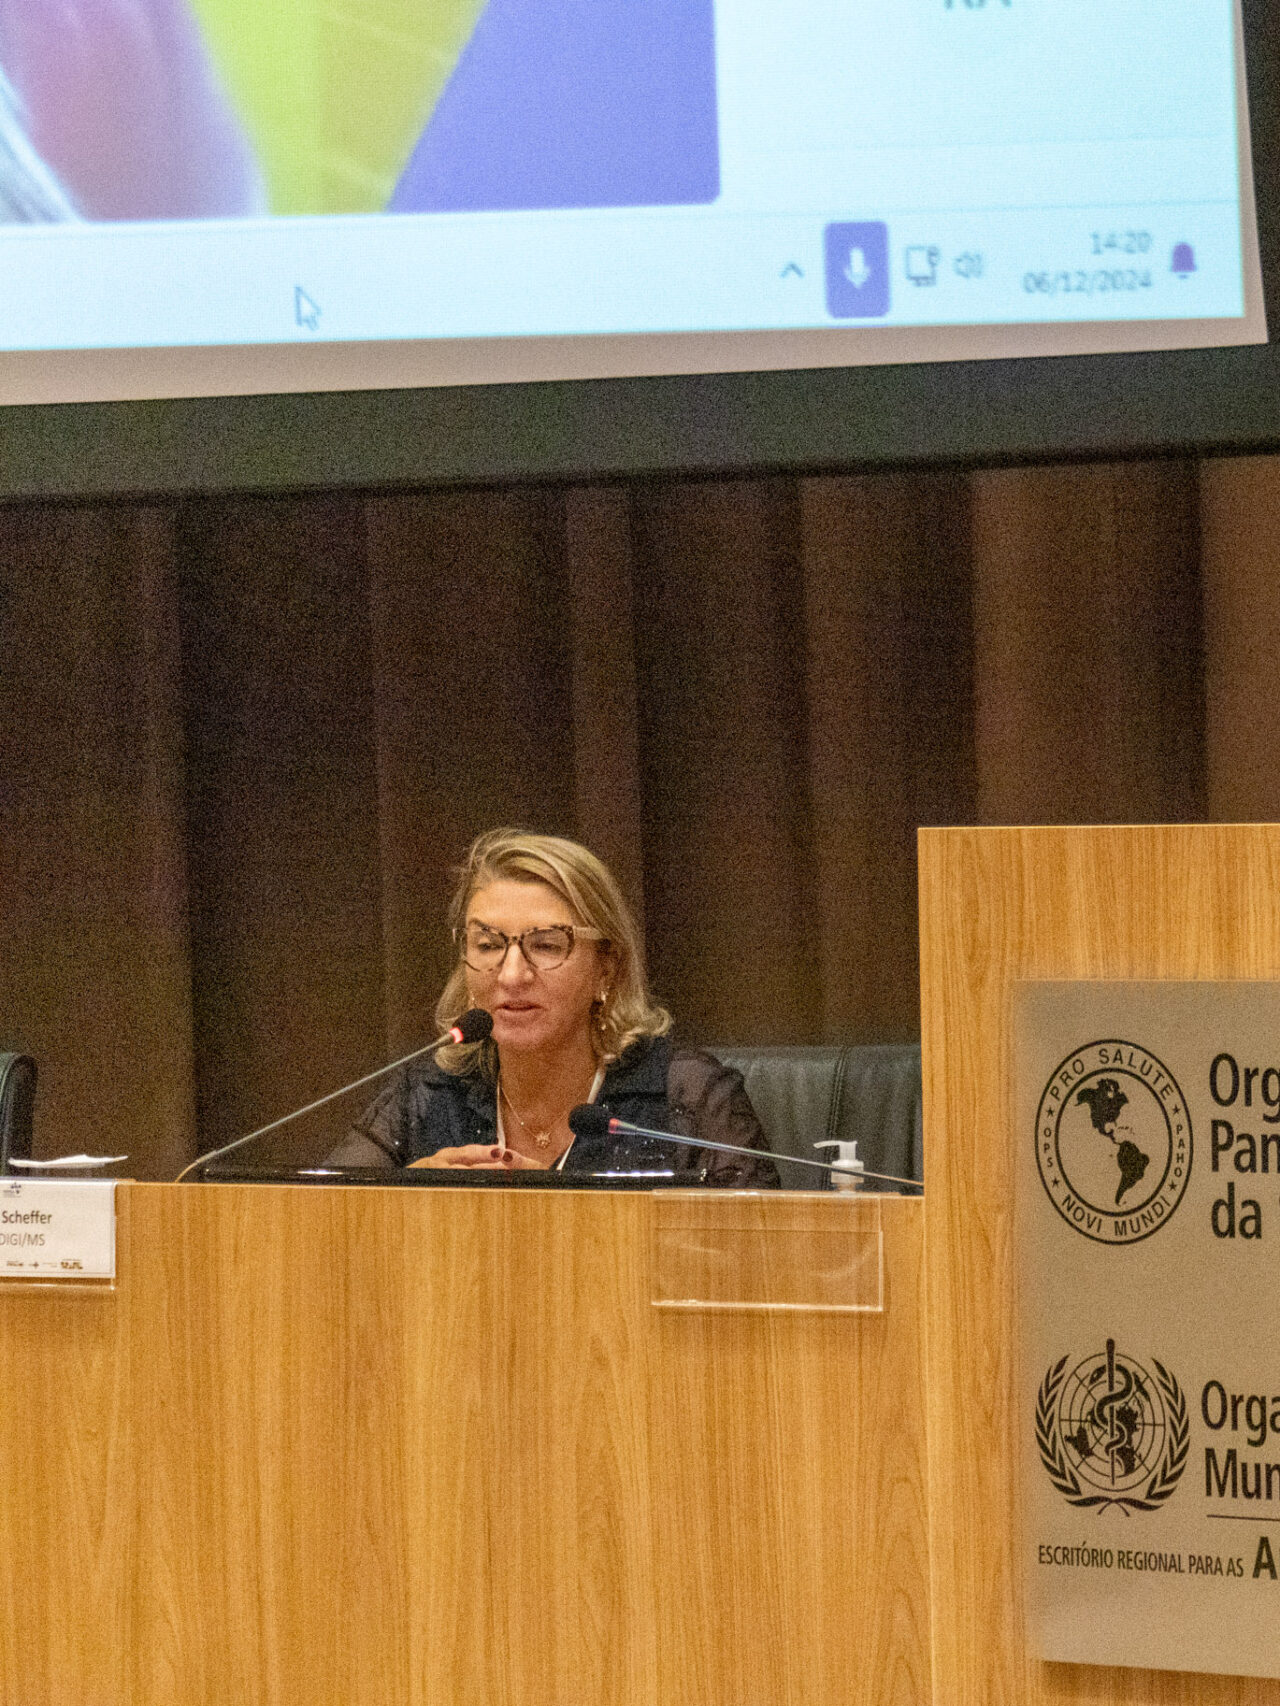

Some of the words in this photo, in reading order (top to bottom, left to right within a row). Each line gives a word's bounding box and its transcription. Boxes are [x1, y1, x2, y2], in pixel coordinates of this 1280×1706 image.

[1090, 231, 1152, 254] 14:20
[1023, 269, 1152, 294] 06/12/2024
[1050, 1058, 1085, 1101] PRO
[1098, 1048, 1174, 1100] SALUTE
[1043, 1126, 1054, 1168] OPS
[1174, 1124, 1186, 1178] PAHO
[1, 1210, 53, 1225] Scheffer
[1061, 1194, 1103, 1233] NOVI
[1114, 1195, 1171, 1237] MUNDI
[1210, 1182, 1262, 1240] da
[1038, 1541, 1114, 1569] ESCRITÓRIO
[1117, 1549, 1185, 1574] REGIONAL
[1188, 1555, 1224, 1577] PARA
[1226, 1557, 1244, 1578] AS
